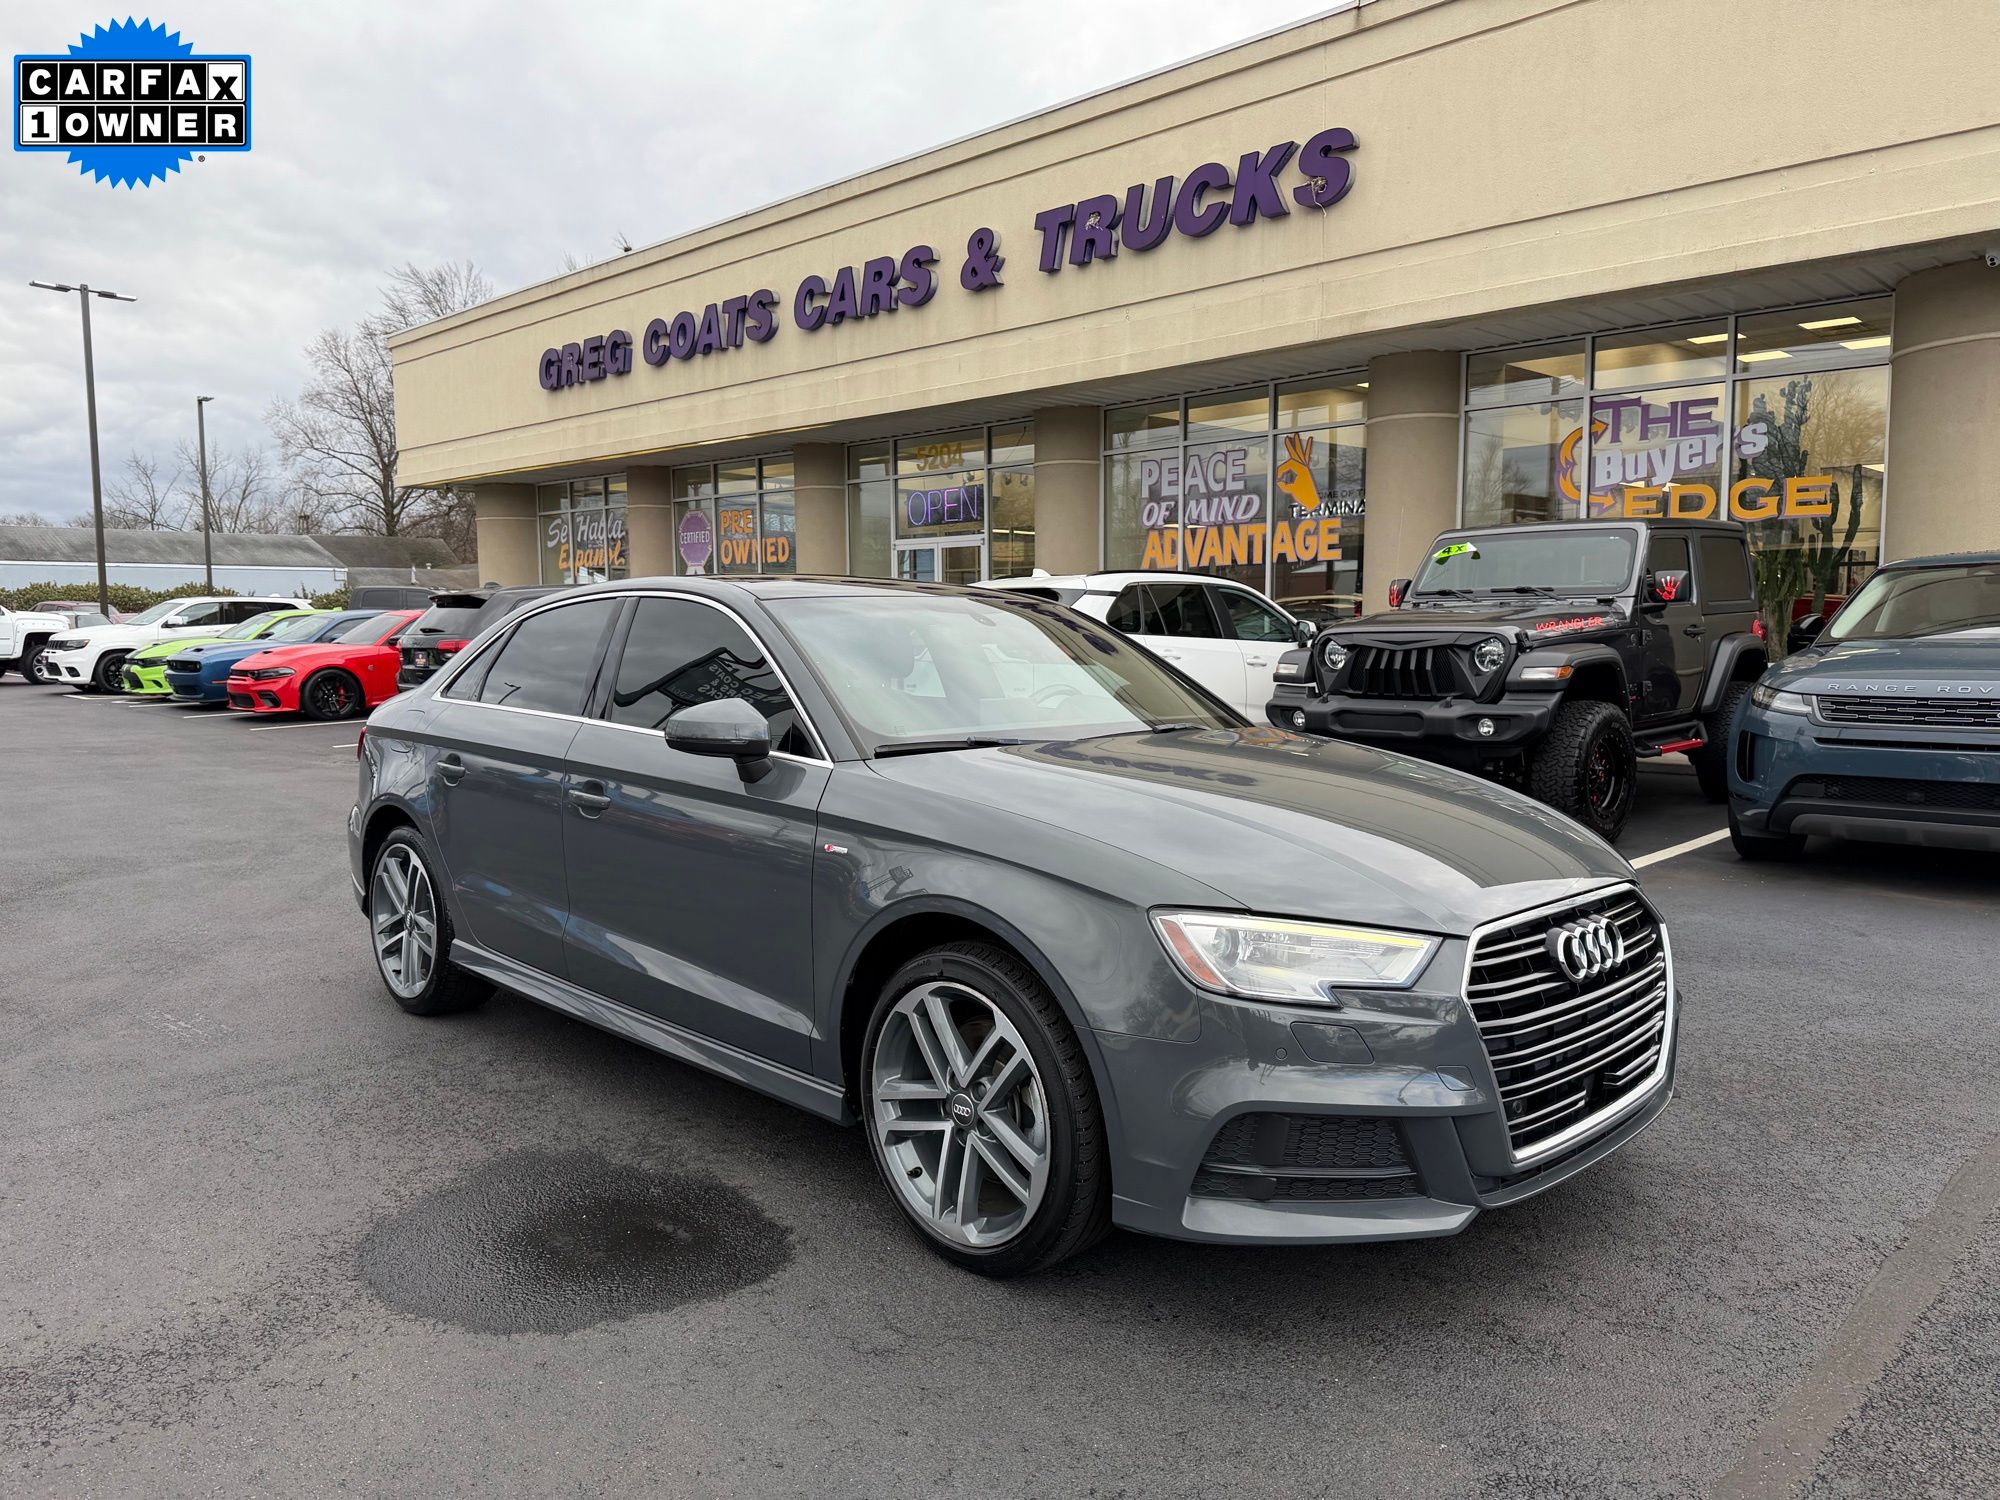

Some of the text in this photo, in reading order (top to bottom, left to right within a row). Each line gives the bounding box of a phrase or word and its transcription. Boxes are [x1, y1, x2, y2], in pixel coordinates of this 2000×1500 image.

[539, 127, 1361, 391] GREG COATS CARS & TRUCKS
[1592, 395, 1719, 444] THE
[915, 442, 965, 472] 5204
[1140, 449, 1247, 499] PEACE
[908, 486, 978, 526] OPEN
[1142, 493, 1261, 529] OF MIND
[1623, 474, 1833, 521] EDGE
[547, 511, 626, 548] Se Habla
[680, 530, 710, 544] CERTIFIED
[720, 508, 753, 536] PRE
[720, 536, 790, 566] OWNED
[1140, 517, 1343, 570] ADVANTAGE
[1536, 615, 1606, 633] WRANGLER
[1827, 683, 1994, 694] RANGE ROV
